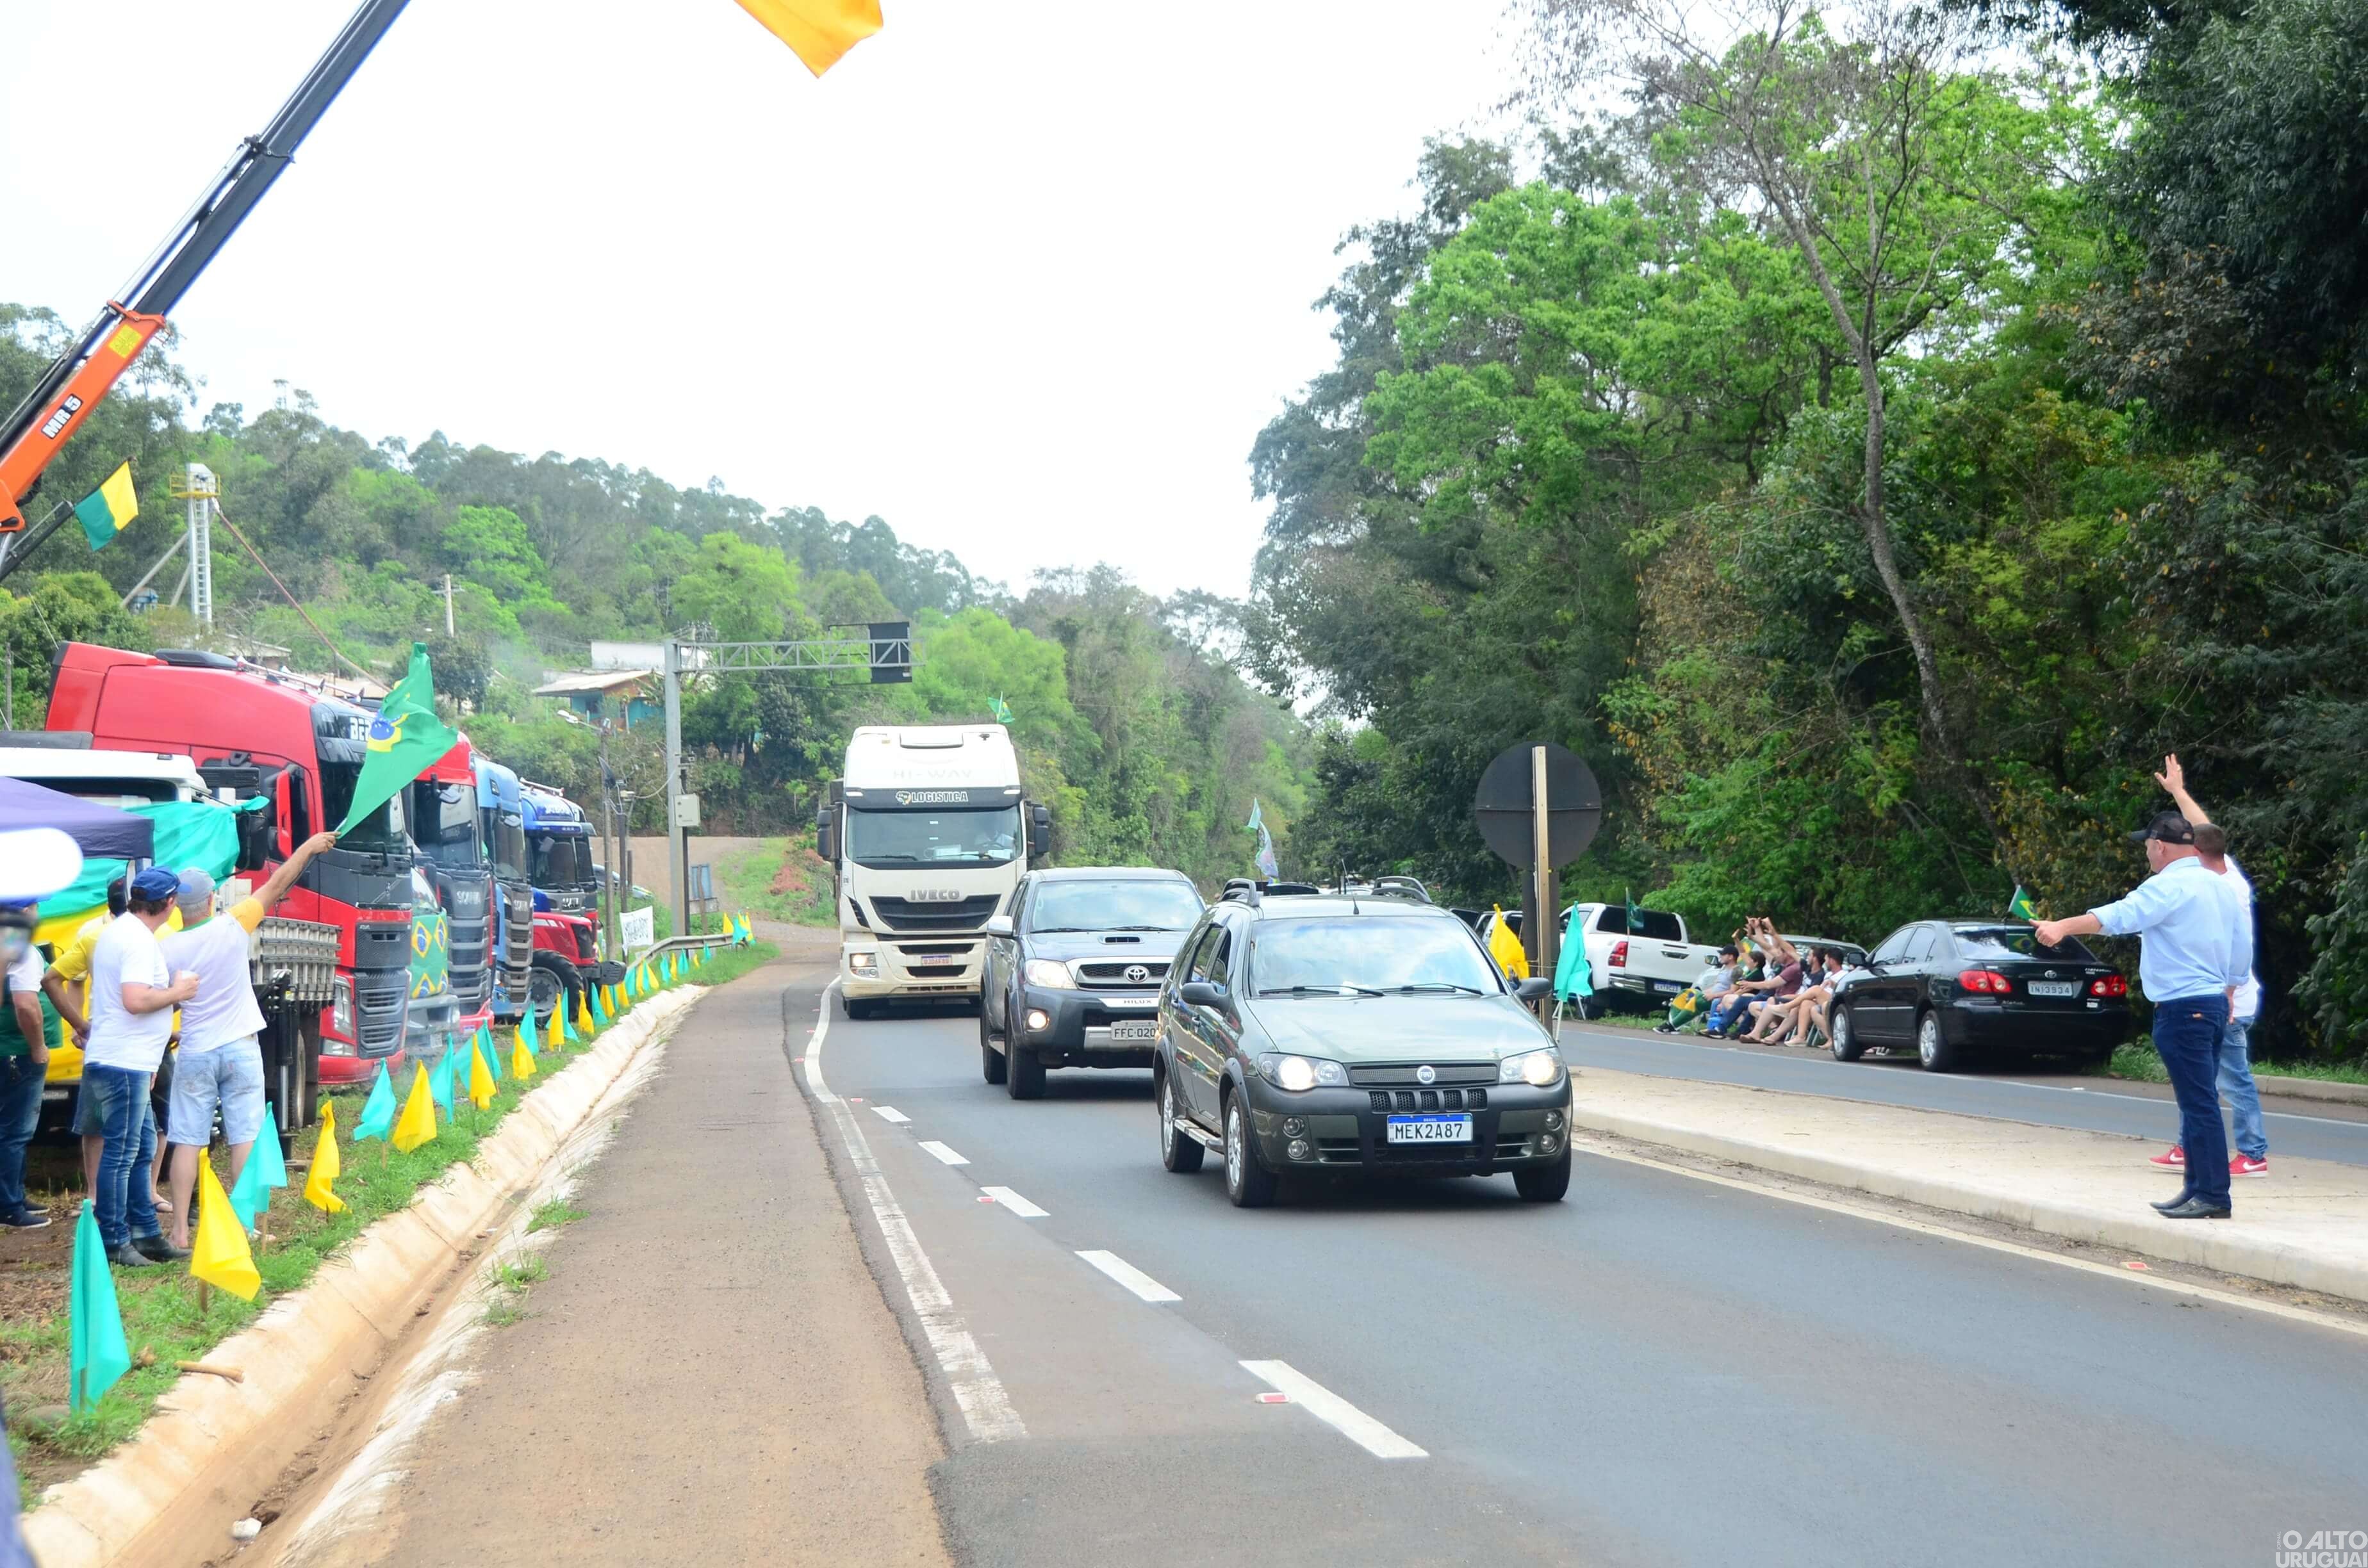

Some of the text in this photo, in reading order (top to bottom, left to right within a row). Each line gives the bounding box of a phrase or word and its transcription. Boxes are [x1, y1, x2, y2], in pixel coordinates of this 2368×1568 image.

[42, 395, 81, 438] MR 5
[911, 791, 969, 803] LOGISTICA
[910, 888, 960, 901] IVECO
[1395, 1123, 1463, 1139] MEK2A87
